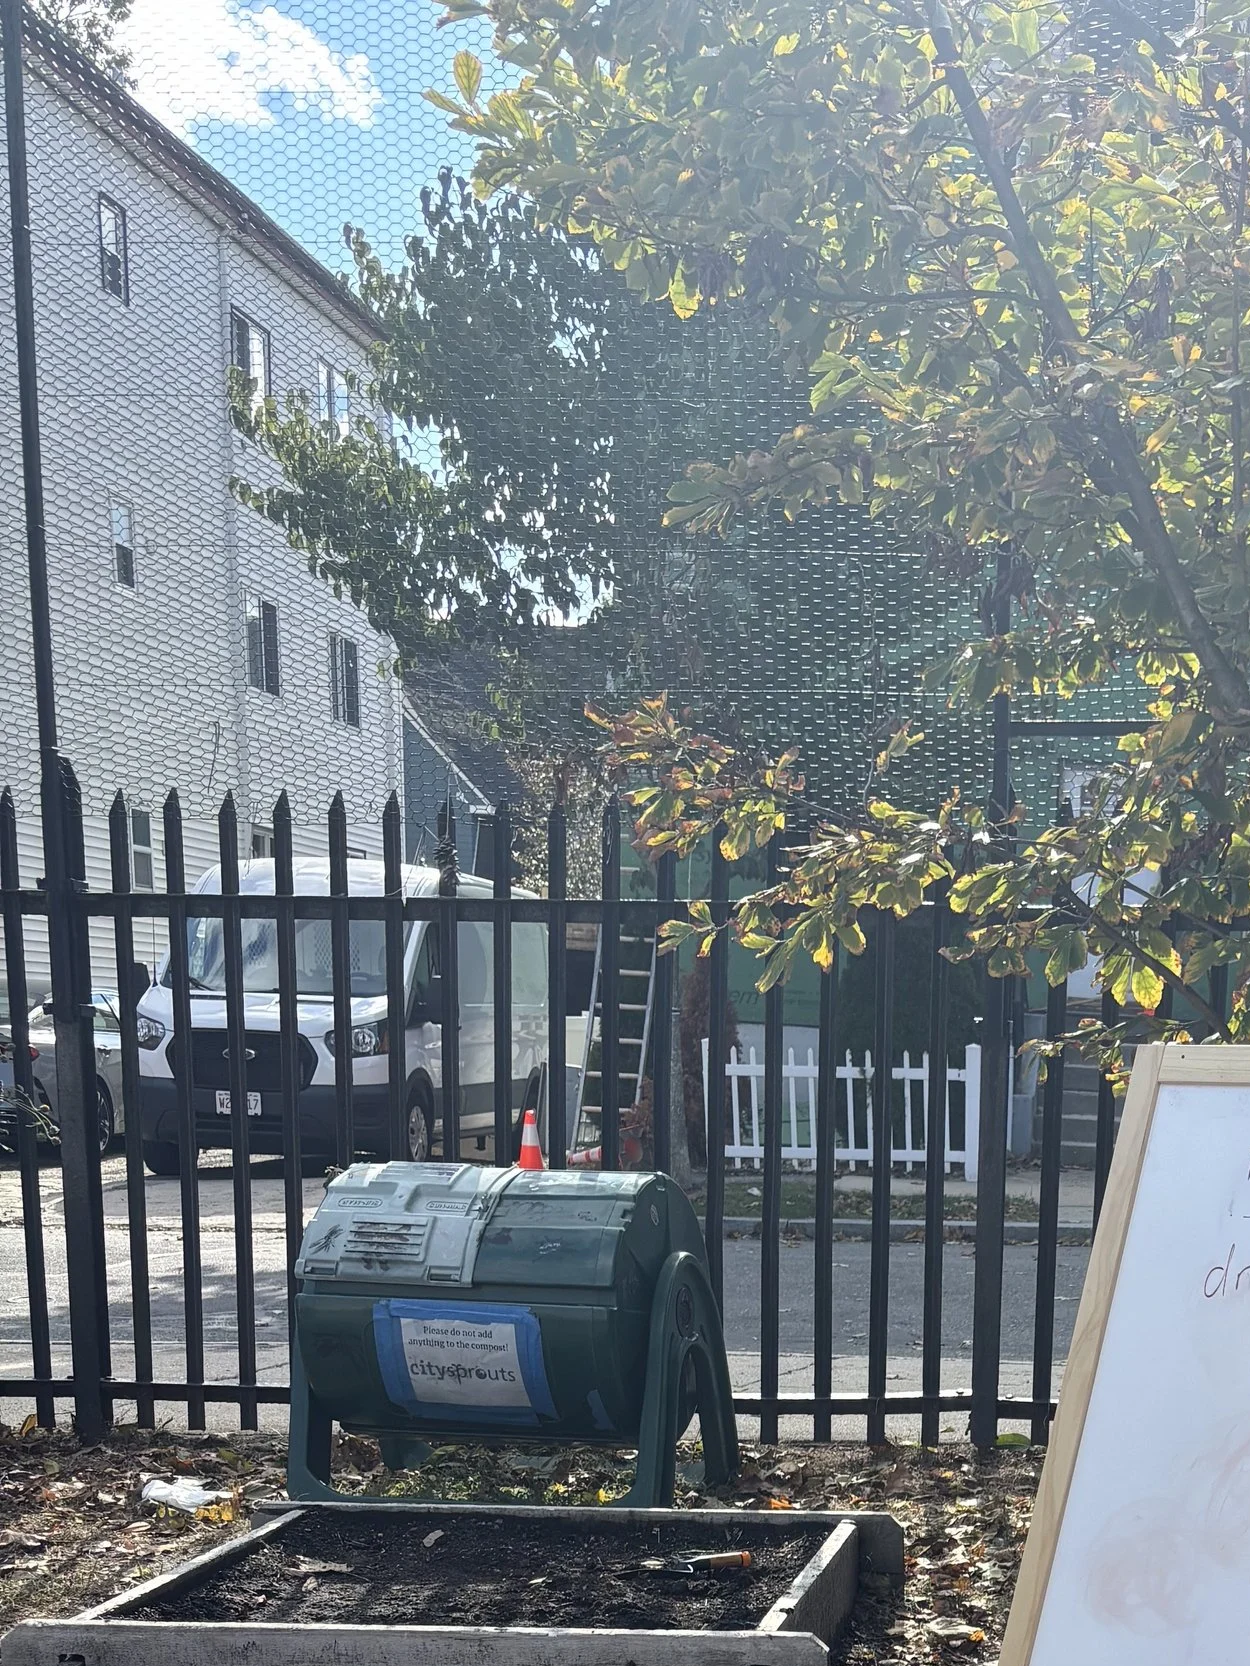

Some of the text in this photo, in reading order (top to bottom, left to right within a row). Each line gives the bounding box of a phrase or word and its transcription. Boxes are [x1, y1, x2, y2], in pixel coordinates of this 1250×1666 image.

[219, 1097, 258, 1110] W217
[423, 1326, 493, 1338] Please do not add
[408, 1337, 509, 1353] anything to the compost!
[410, 1360, 516, 1385] citysprouts
